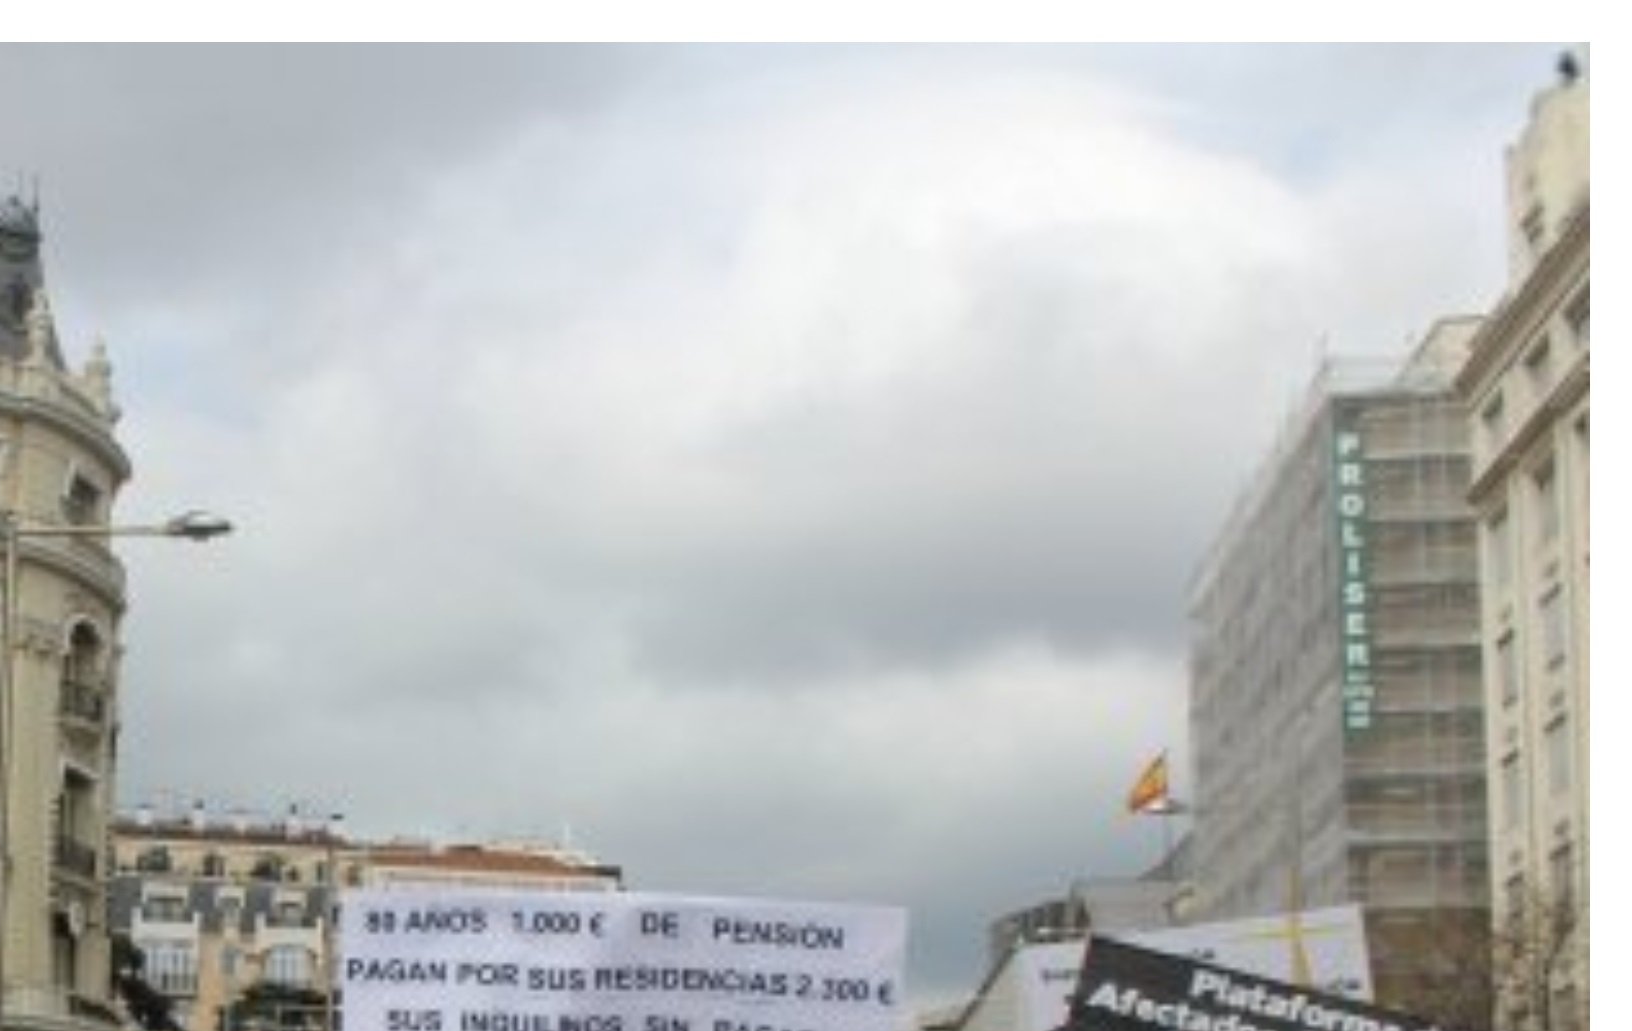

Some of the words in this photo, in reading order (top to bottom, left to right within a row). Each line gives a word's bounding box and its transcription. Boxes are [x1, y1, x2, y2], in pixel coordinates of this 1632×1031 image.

[640, 911, 679, 938] DE
[347, 957, 447, 982] PAGAN
[456, 962, 519, 985] POR
[528, 968, 586, 990] SUS
[595, 966, 788, 996] RESIDENCIAS
[387, 1009, 442, 1031] SUS
